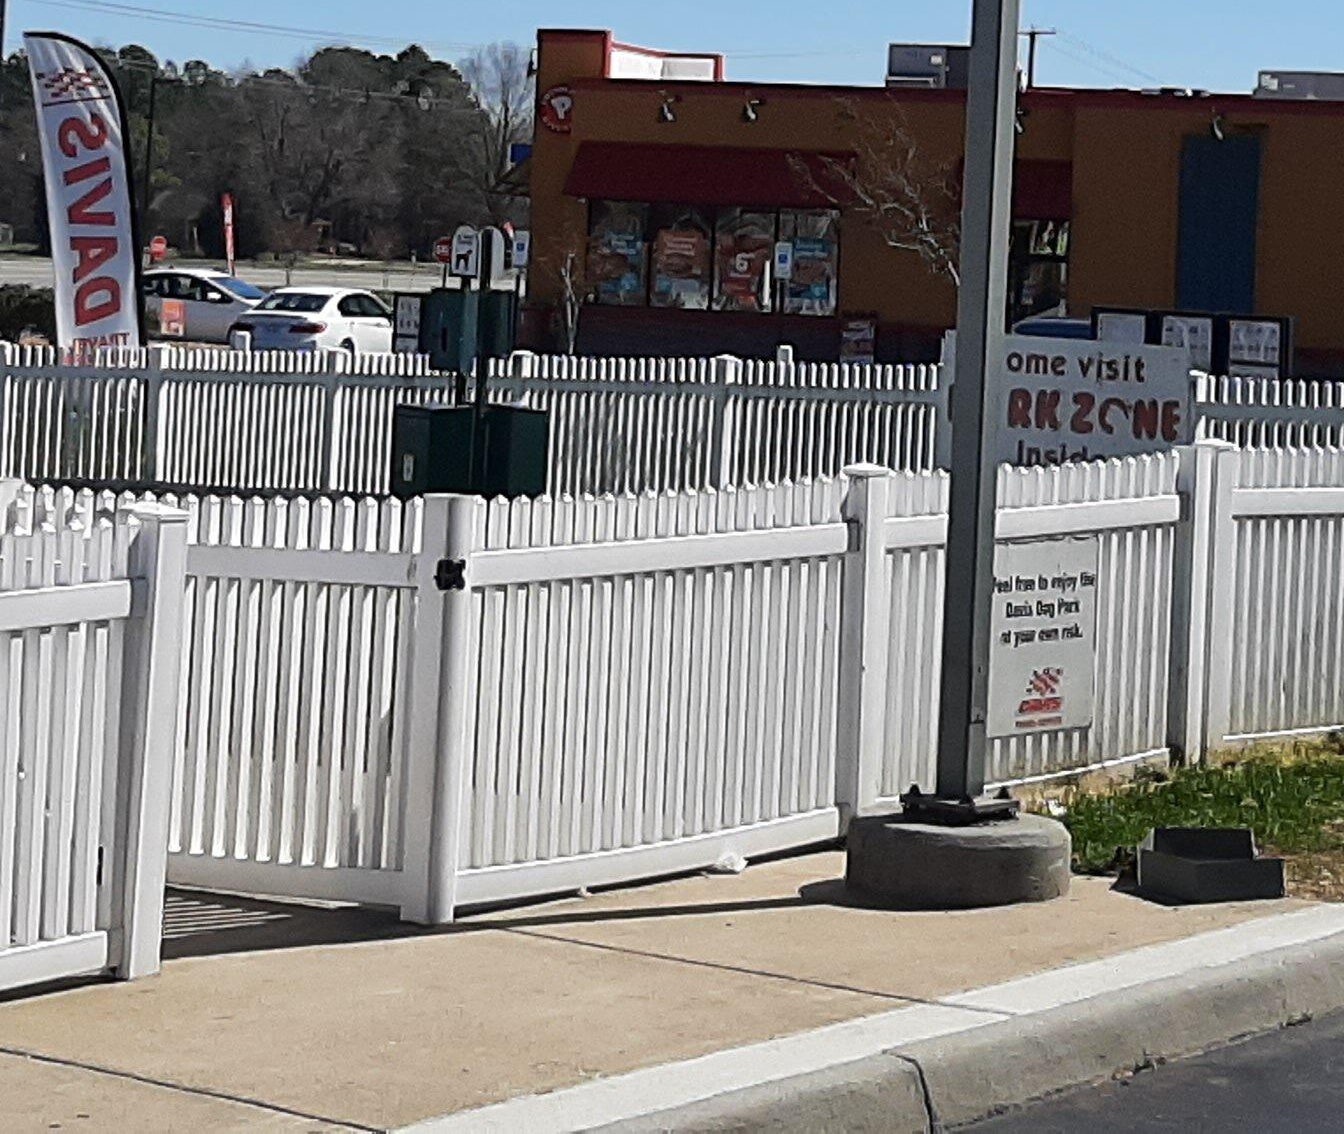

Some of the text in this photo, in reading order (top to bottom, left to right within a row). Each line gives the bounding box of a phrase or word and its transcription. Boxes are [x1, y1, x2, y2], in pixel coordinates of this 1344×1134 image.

[1006, 351, 1145, 383] ome visit
[1008, 388, 1061, 432] RK
[1036, 600, 1055, 618] Dog
